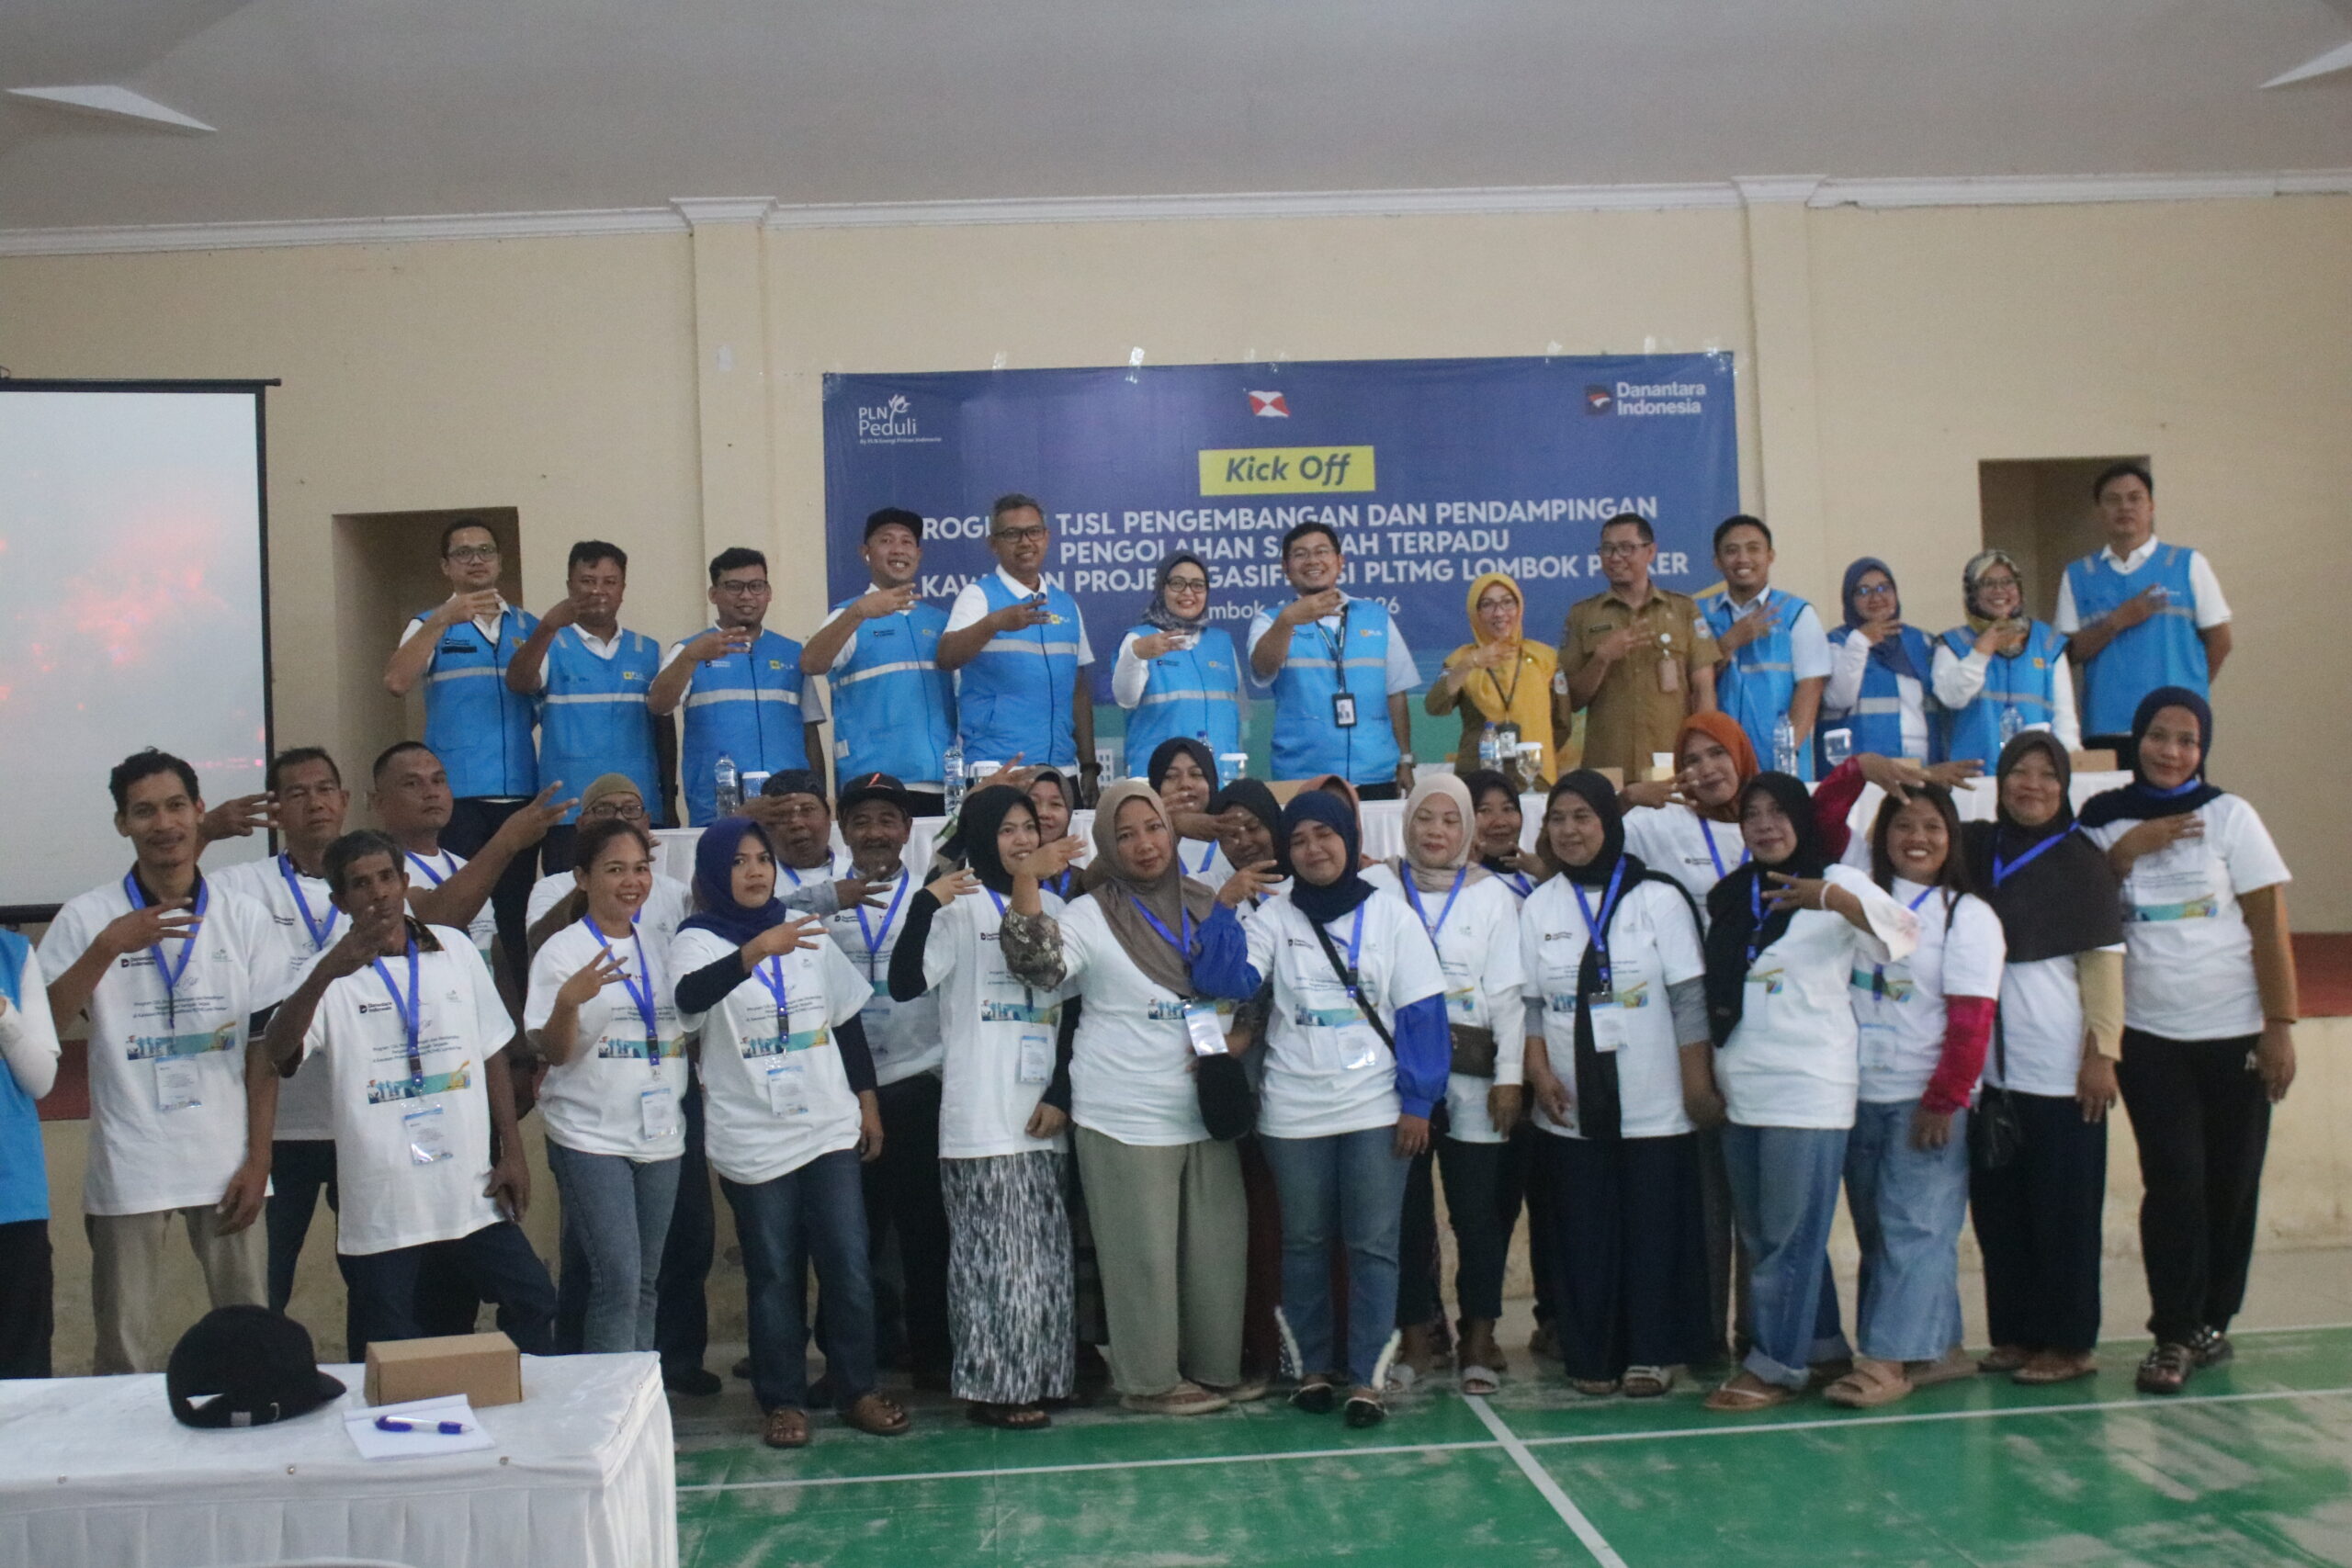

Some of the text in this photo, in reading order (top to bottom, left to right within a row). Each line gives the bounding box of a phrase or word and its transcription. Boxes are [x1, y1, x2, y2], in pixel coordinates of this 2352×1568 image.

[1616, 381, 1706, 398] Danantara
[859, 407, 888, 420] PLN
[1617, 398, 1701, 416] Indonesia
[859, 417, 917, 436] Peduli
[1226, 453, 1351, 486] Kick Off
[1056, 496, 1657, 536] TJSL PENGEMBANGAN DAN PENDAMPINGAN
[1386, 528, 1510, 555] TERPADU
[1364, 558, 1454, 584] PLTMG
[1462, 555, 1579, 582] LOMBOK
